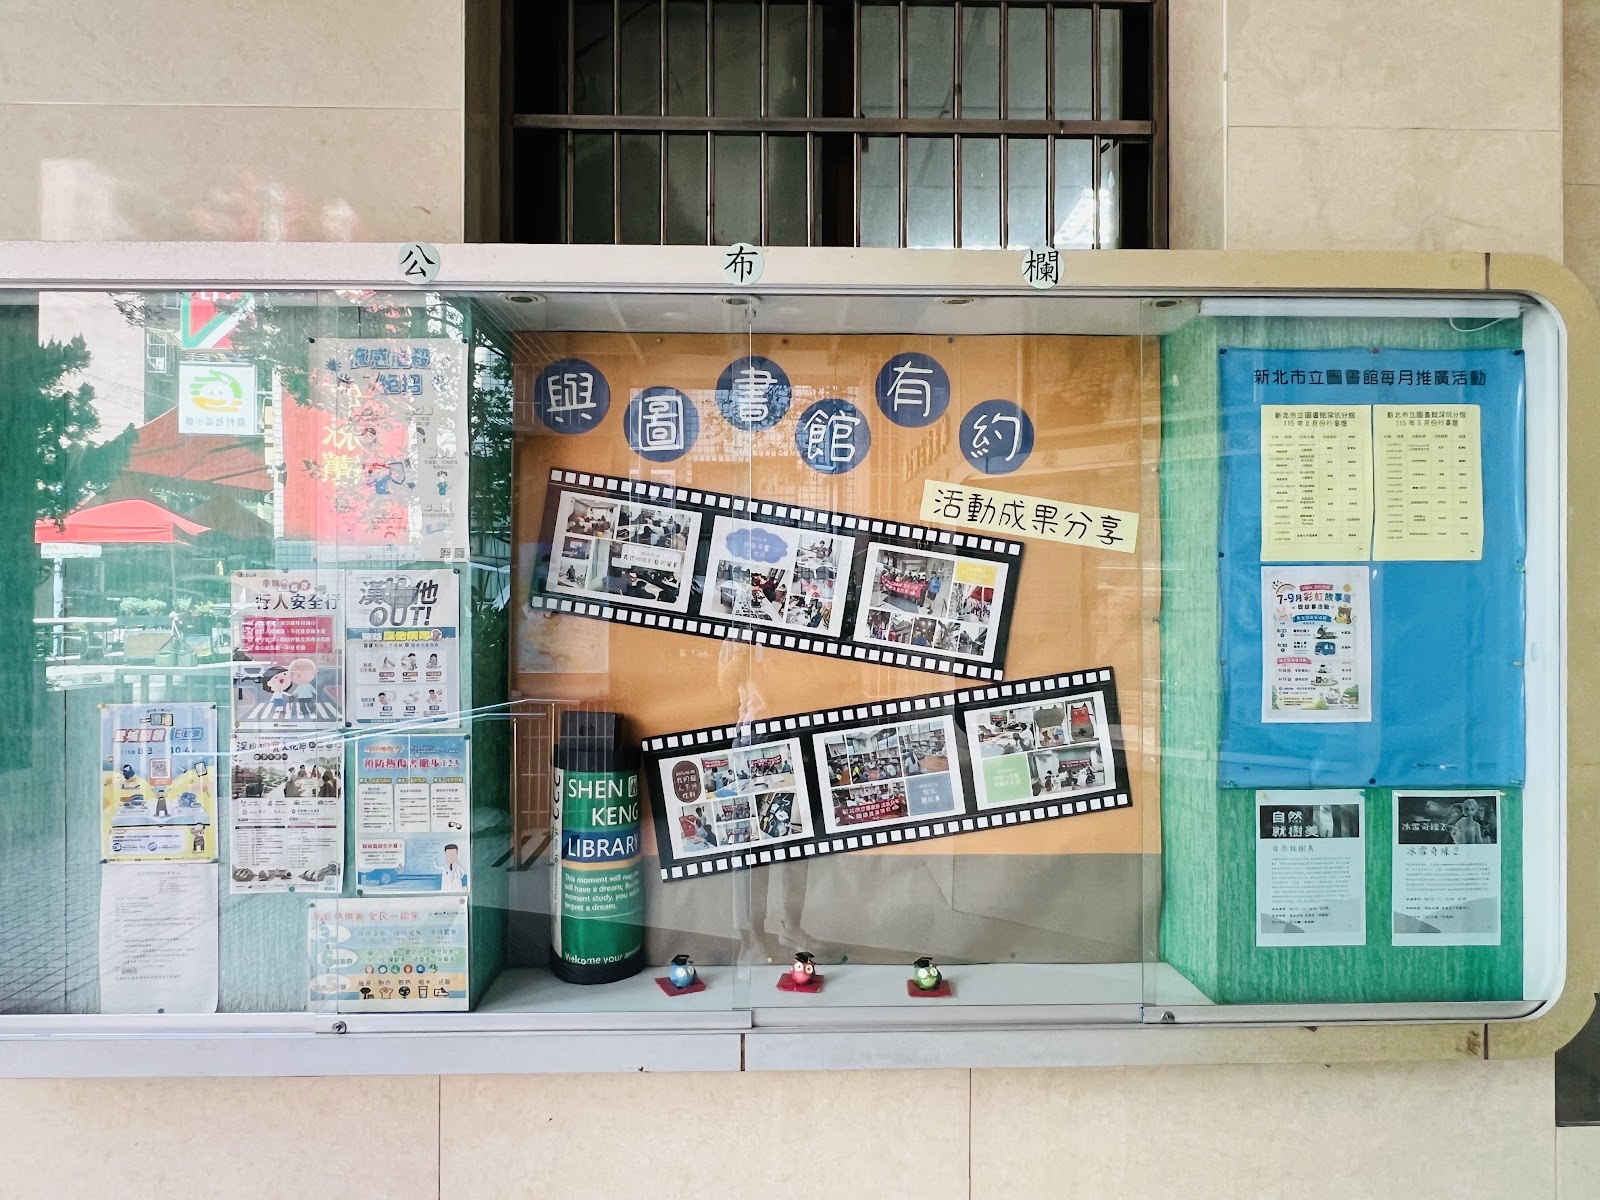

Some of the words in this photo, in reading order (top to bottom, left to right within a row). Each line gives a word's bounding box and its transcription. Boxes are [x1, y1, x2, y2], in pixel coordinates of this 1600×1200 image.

[400, 245, 436, 279] 公
[725, 246, 758, 282] 布
[1023, 250, 1060, 284] 欄
[1254, 369, 1486, 386] 新北市立圖書館每月推廣活動
[933, 482, 1124, 546] 活動成果分享
[369, 606, 432, 627] OUT!
[568, 778, 623, 799] SHEN
[592, 802, 638, 827] KENG
[1272, 810, 1303, 824] 自然
[576, 876, 608, 884] moment
[609, 873, 622, 882] will
[574, 885, 591, 893] have
[565, 951, 601, 965] Welcome
[603, 954, 624, 964] your
